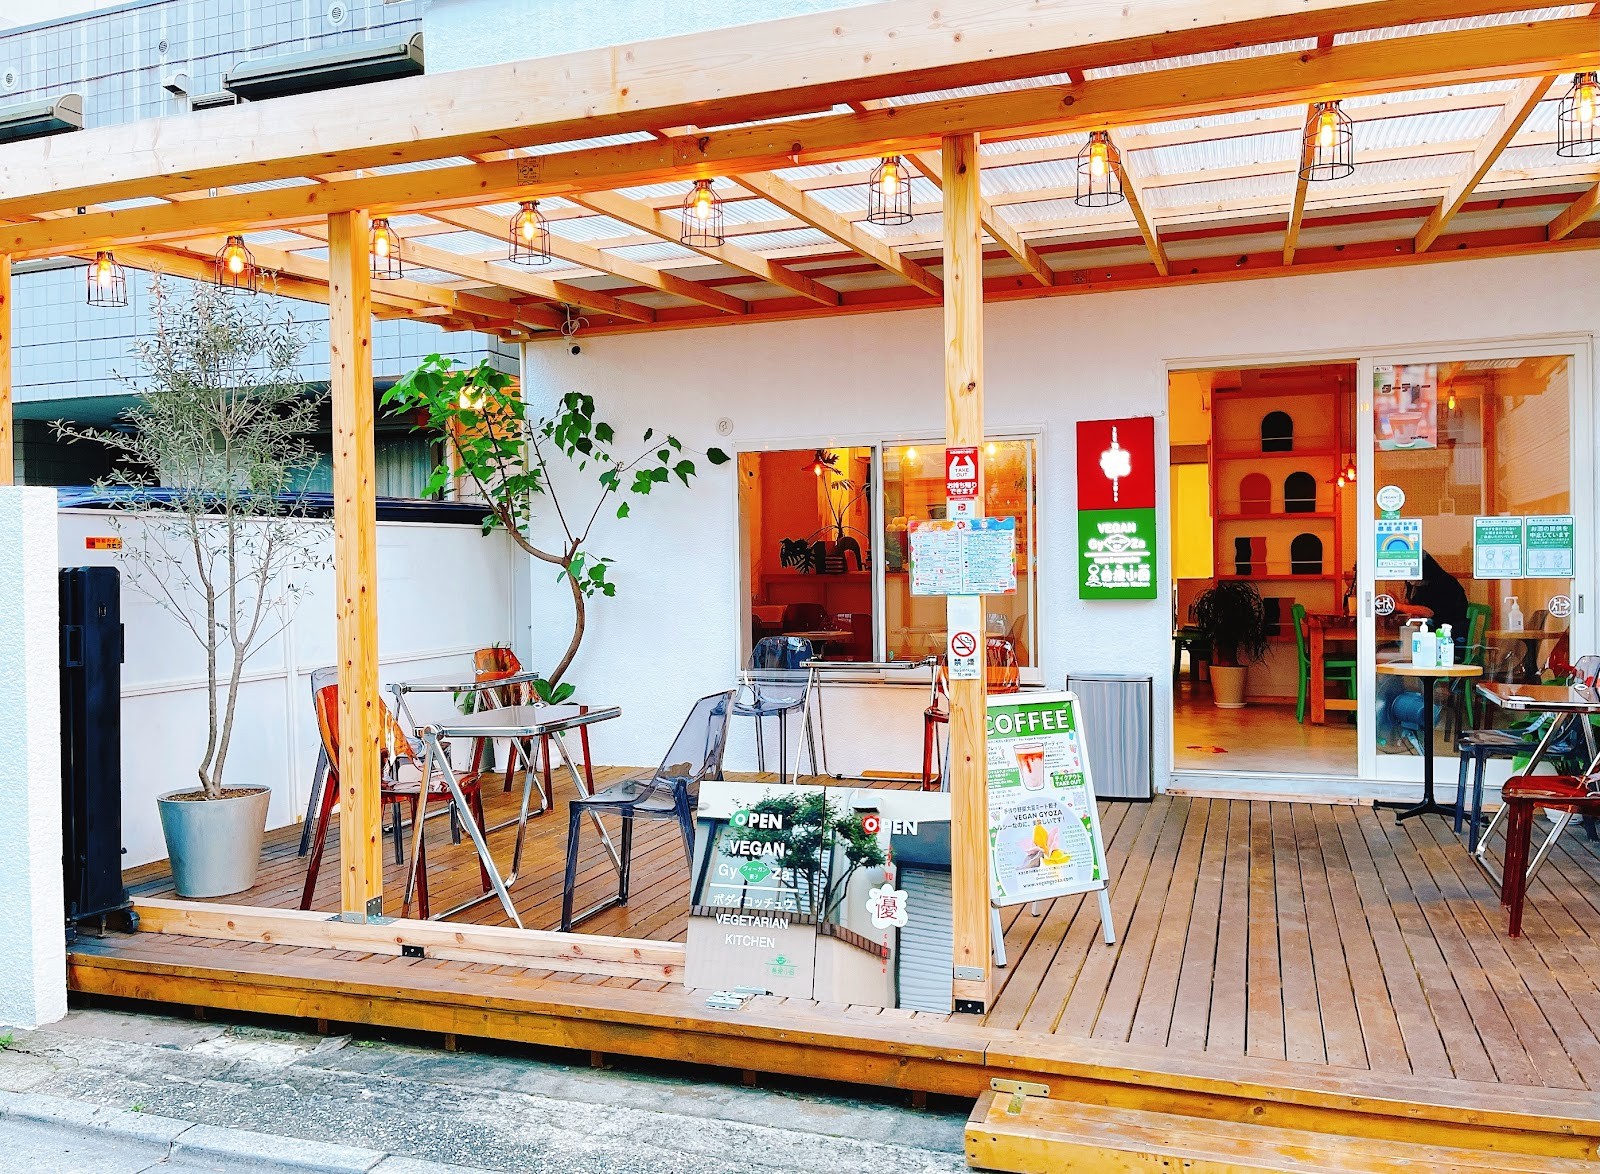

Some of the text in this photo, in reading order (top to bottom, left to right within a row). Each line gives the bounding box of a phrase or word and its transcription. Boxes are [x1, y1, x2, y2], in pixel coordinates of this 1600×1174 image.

[1097, 522, 1137, 534] VEGAN
[987, 709, 1069, 737] COFFEE
[734, 813, 783, 830] OPEN
[1014, 809, 1062, 821] VEGAN GYOZA
[865, 818, 918, 835] OPEN
[730, 840, 785, 857] VEGAN
[742, 863, 768, 873] ヴィーガン
[713, 894, 794, 910] ボダイコッチュウ
[876, 894, 898, 920] 優
[716, 913, 789, 929] VEGETARIAN
[725, 934, 775, 948] KITCHEN
